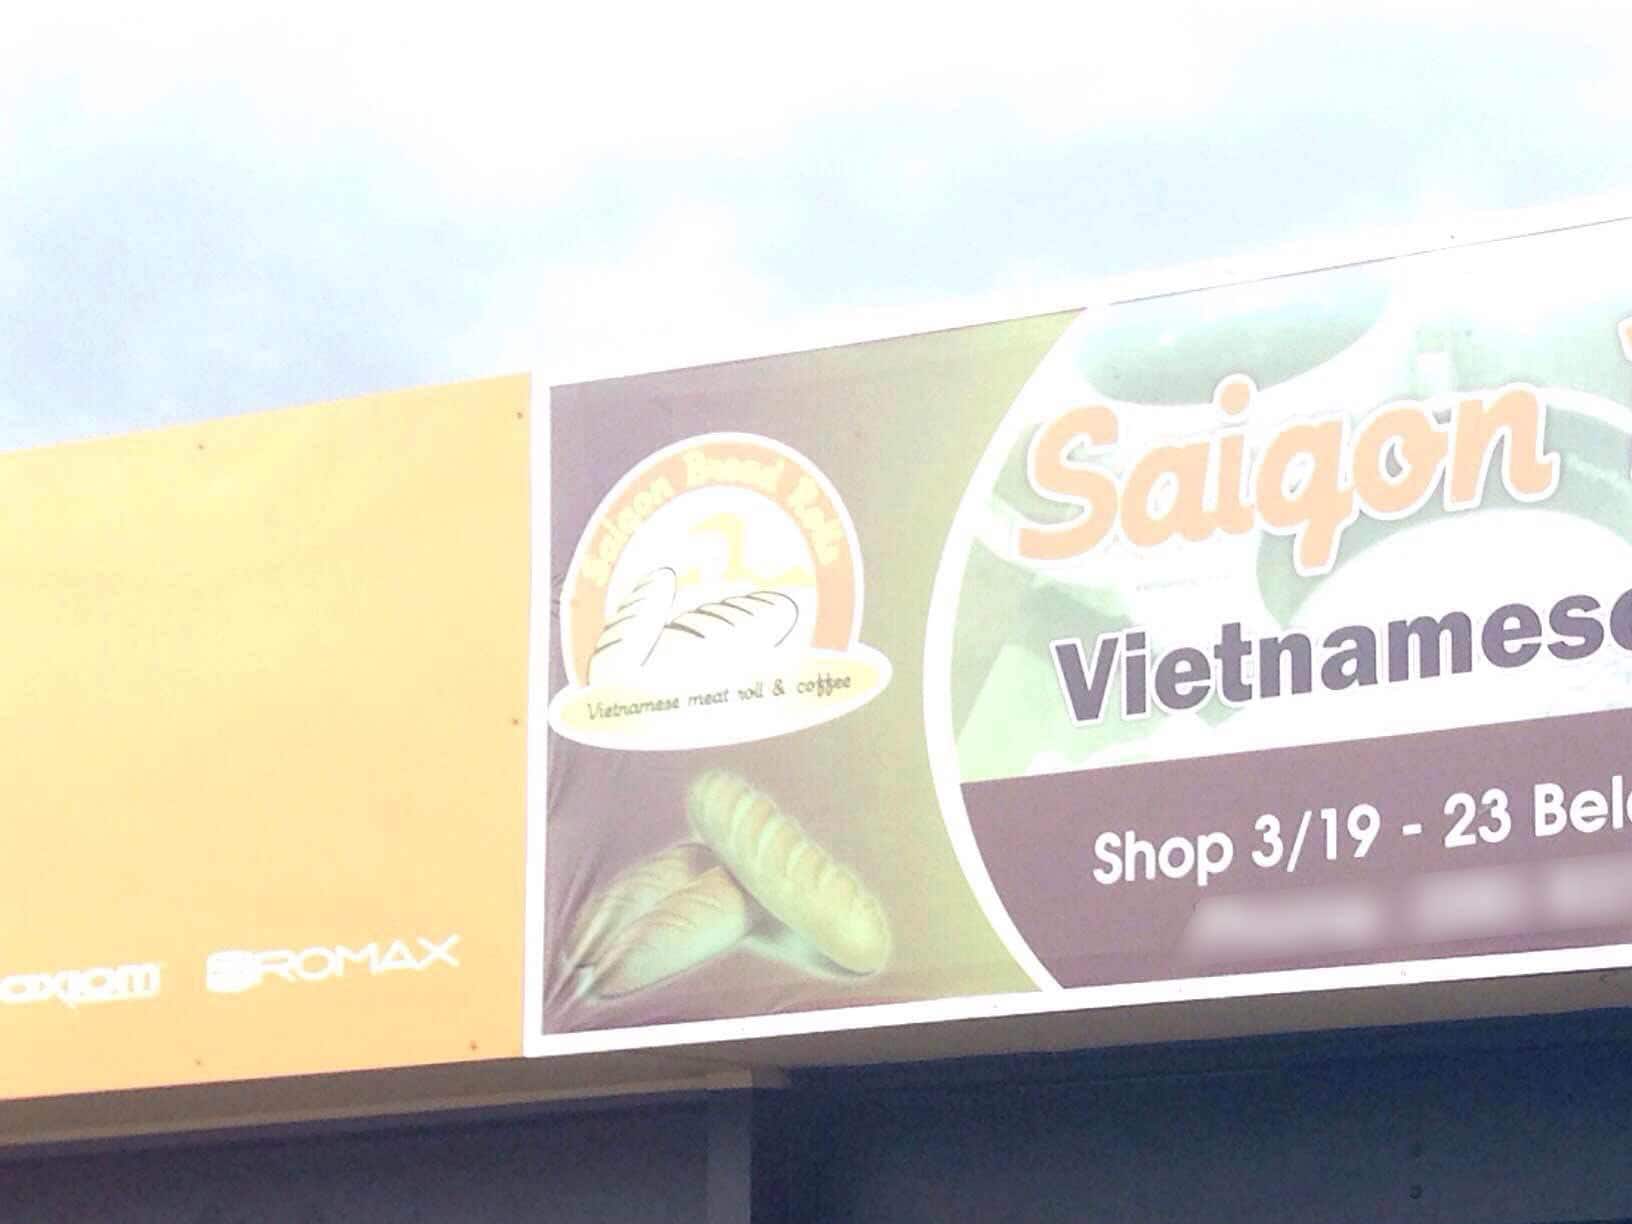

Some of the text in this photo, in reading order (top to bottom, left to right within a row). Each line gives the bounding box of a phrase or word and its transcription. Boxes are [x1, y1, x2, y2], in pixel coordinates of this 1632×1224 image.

[1017, 382, 1556, 568] Saigon
[587, 695, 681, 721] Vietnamese
[688, 691, 730, 709] meat
[773, 680, 785, 697] &
[797, 672, 853, 697] coffee
[1092, 828, 1234, 886] Shop
[1250, 803, 1383, 873] 3/19
[1401, 824, 1422, 835] -
[1443, 788, 1513, 848] 23
